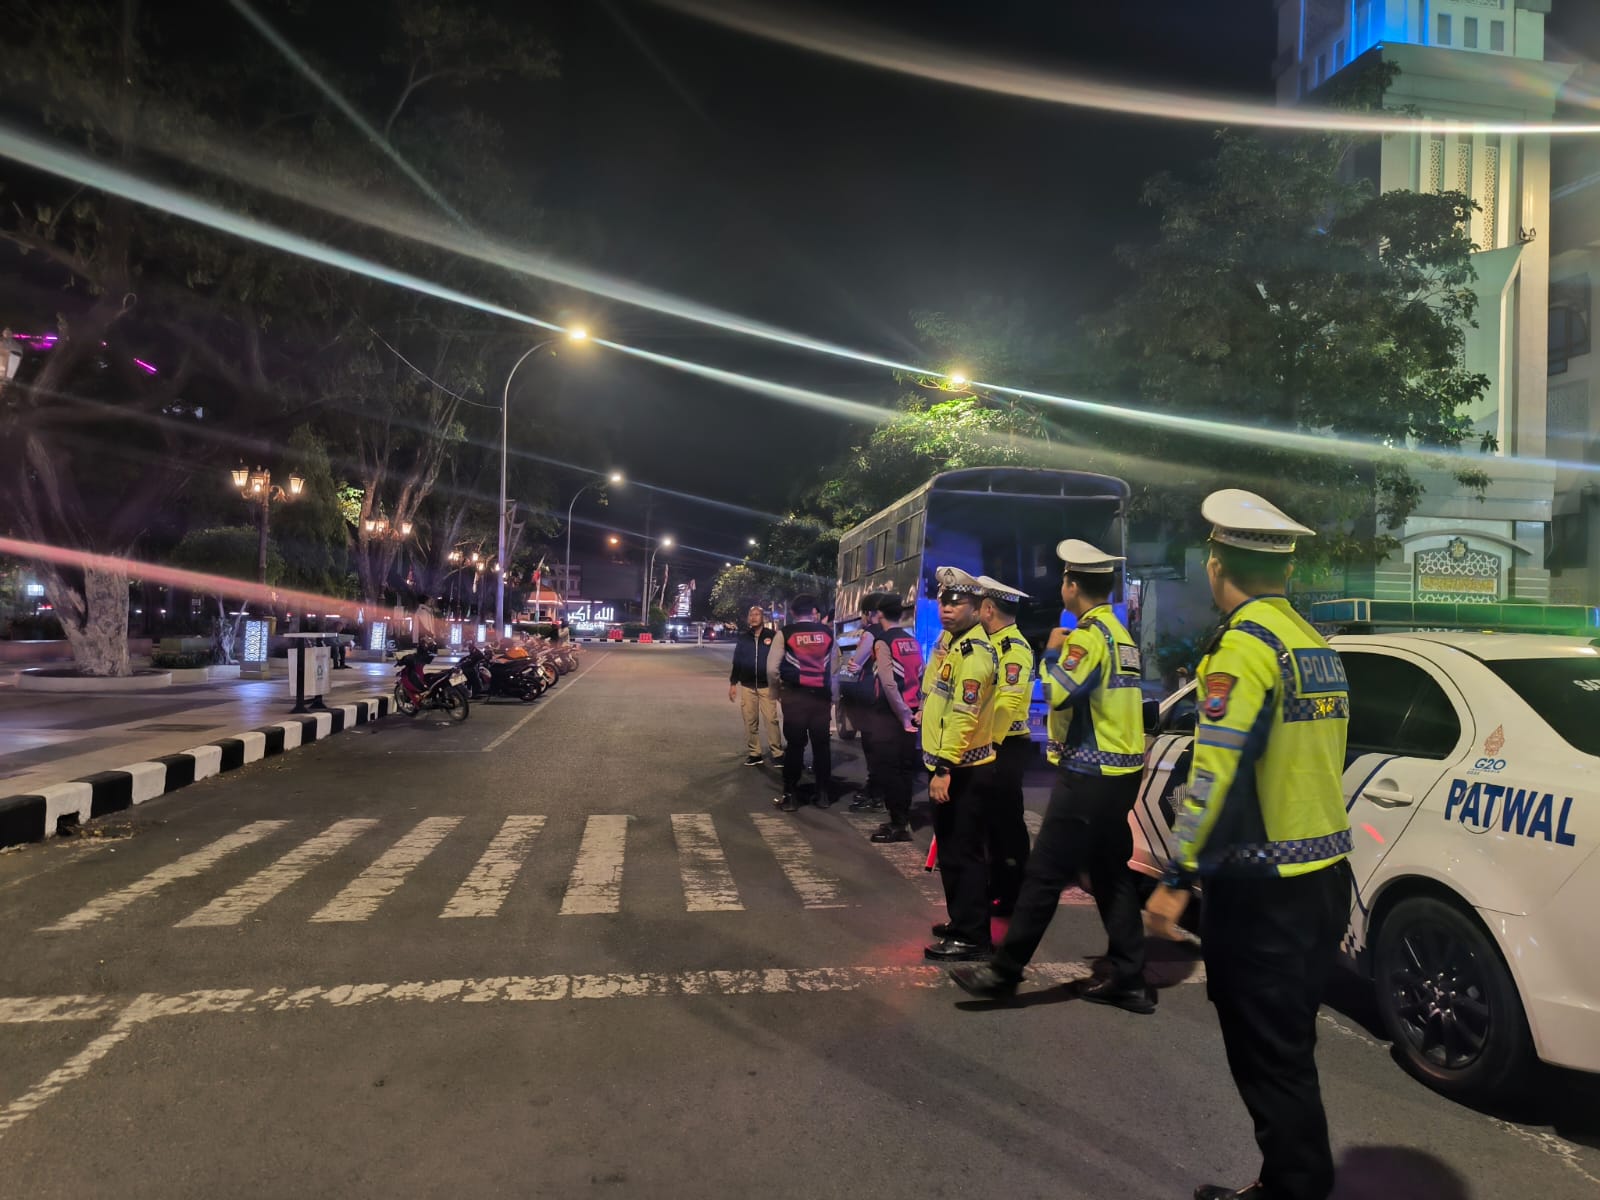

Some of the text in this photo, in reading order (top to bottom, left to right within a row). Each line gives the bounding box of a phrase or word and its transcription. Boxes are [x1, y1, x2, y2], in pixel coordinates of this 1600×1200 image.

[796, 635, 824, 646] POLISI
[1474, 757, 1507, 770] G20
[1444, 778, 1576, 847] PATWAL
